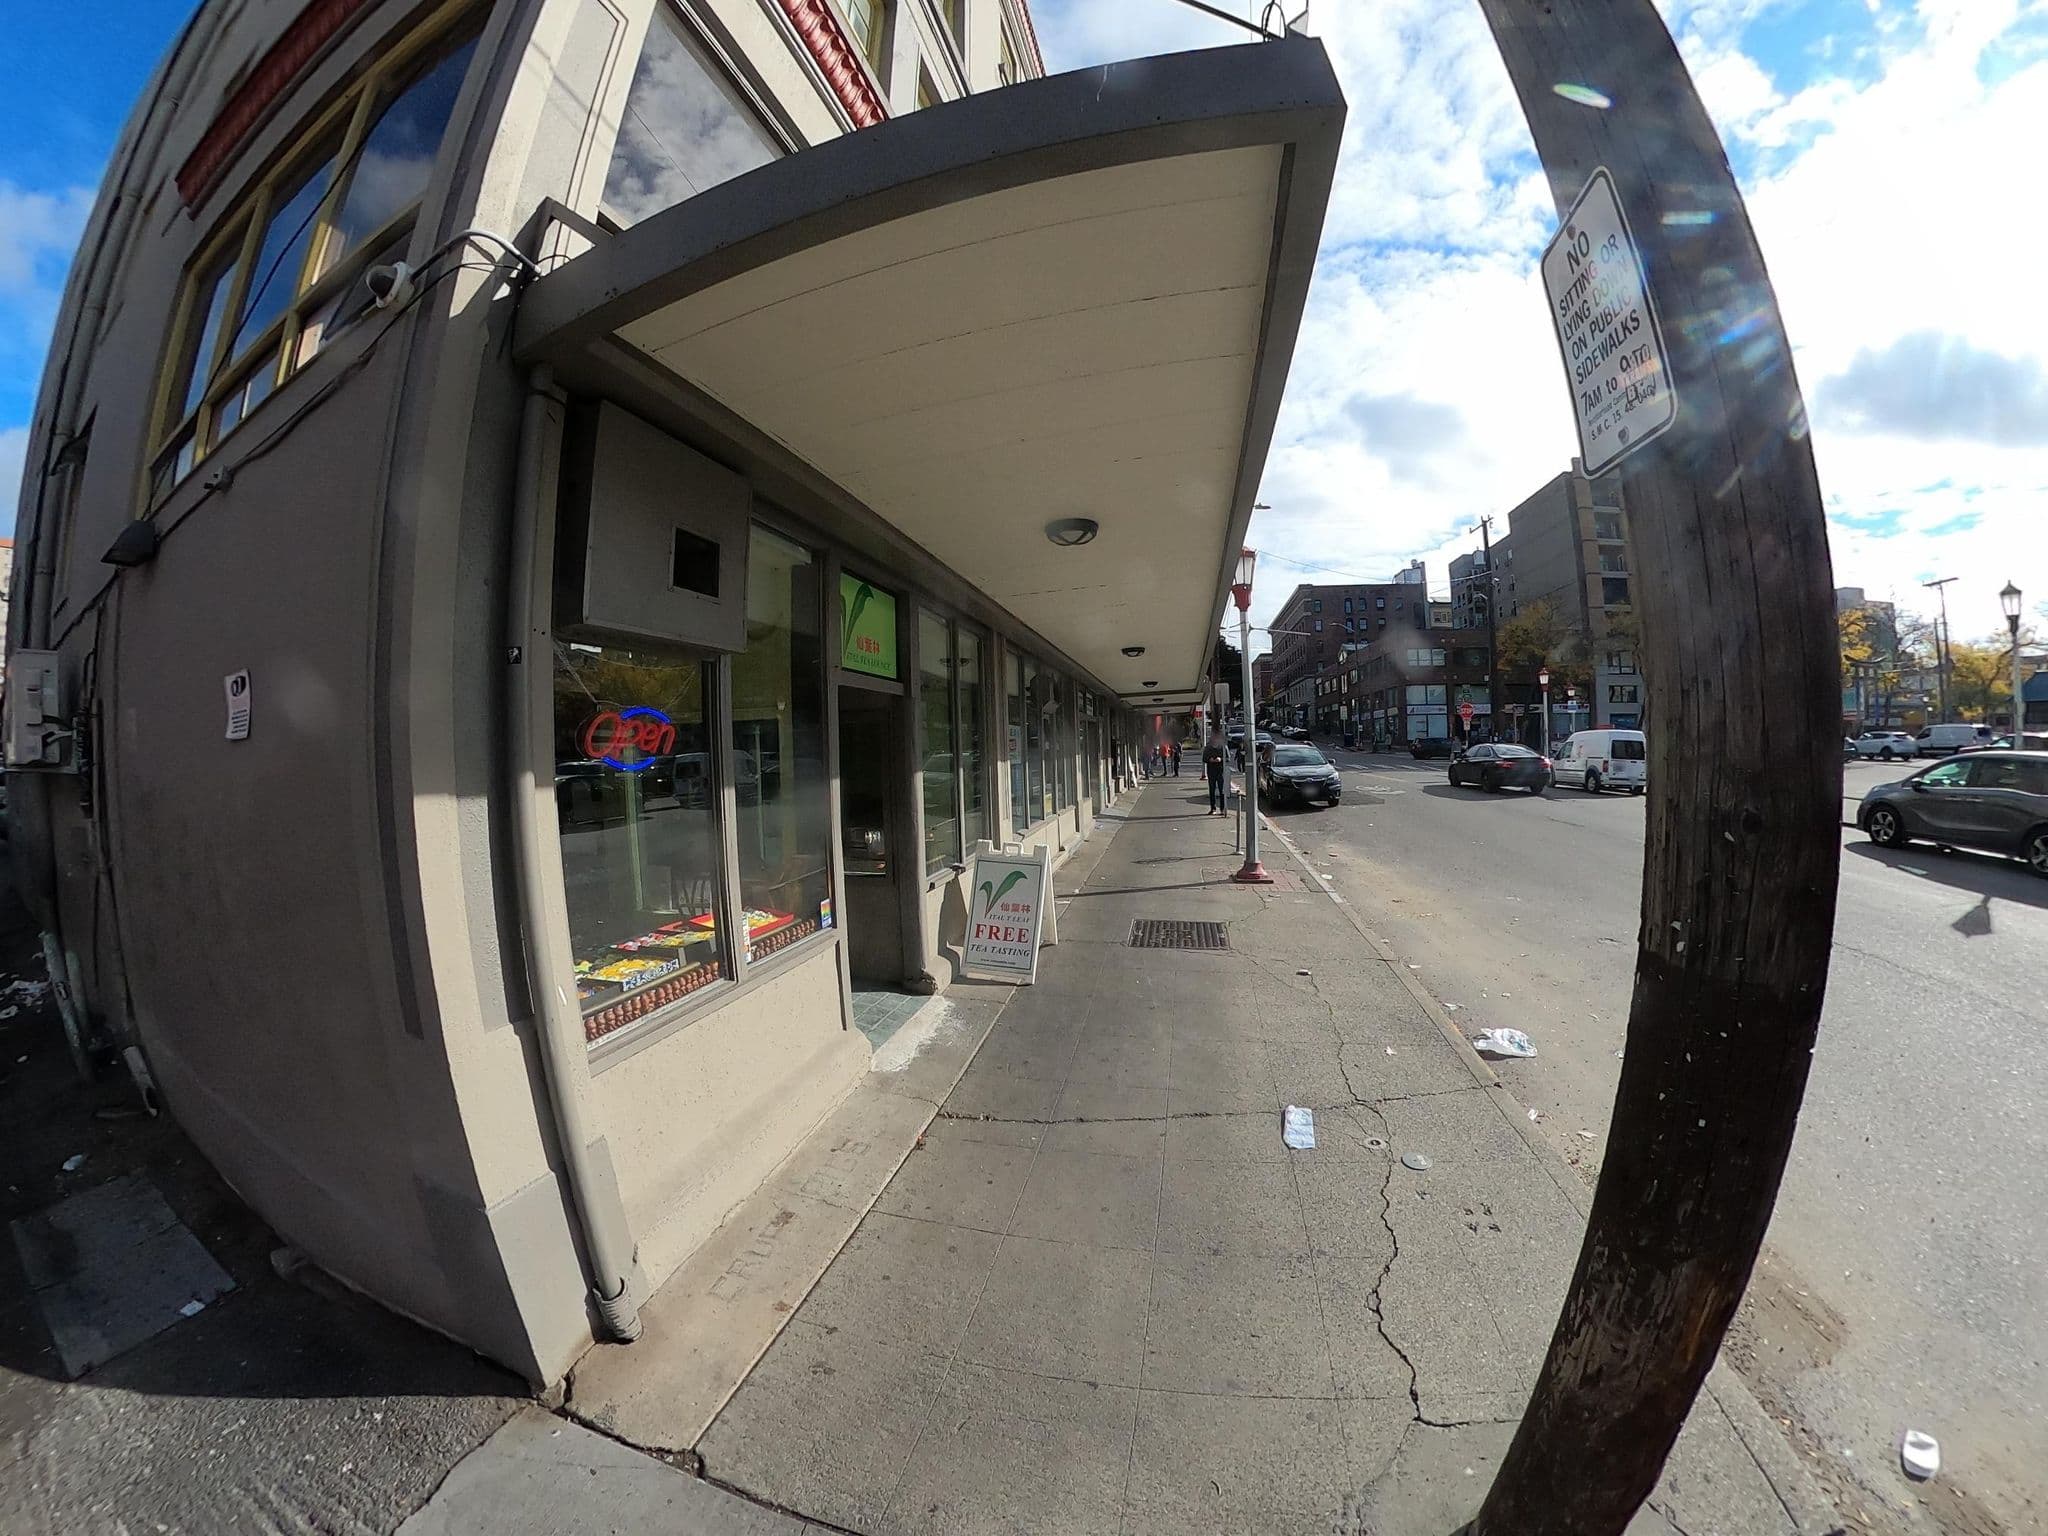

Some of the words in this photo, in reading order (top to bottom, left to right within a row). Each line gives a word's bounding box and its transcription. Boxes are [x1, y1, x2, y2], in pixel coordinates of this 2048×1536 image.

[1559, 260, 1599, 318] SITTING
[1600, 233, 1619, 264] OR
[1566, 230, 1591, 275] NO
[1563, 299, 1591, 342] LYING
[1592, 255, 1629, 307] DOWN
[1571, 332, 1588, 361] ON
[1589, 286, 1632, 342] PUBLIC
[1575, 308, 1641, 385] SIDEWALKS
[1580, 385, 1603, 416] 7AM
[1605, 376, 1618, 394] to
[584, 710, 677, 759] Open
[970, 943, 987, 953] TEA
[990, 945, 1031, 957] TASTING
[974, 923, 1030, 943] FREE
